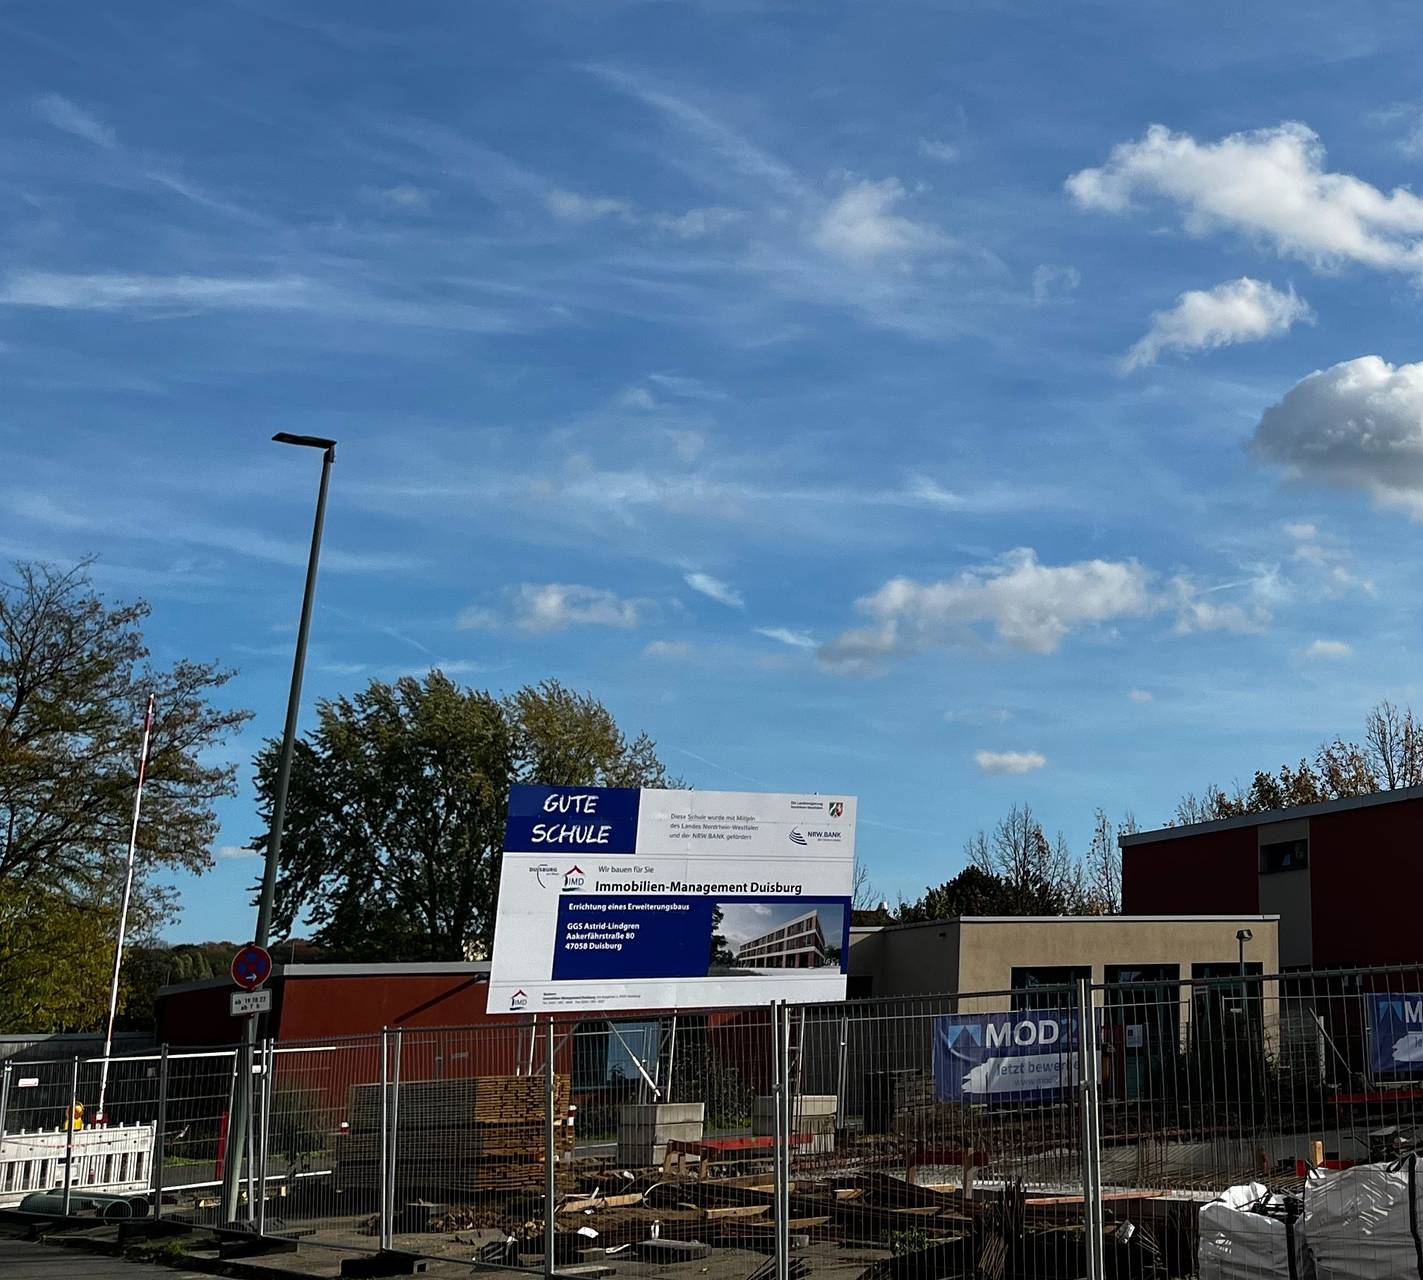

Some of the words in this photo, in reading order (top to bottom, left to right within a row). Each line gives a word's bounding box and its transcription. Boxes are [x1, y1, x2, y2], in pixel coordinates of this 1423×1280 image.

[543, 794, 599, 813] GUTE
[531, 824, 612, 843] SCHULE
[595, 880, 748, 895] Immobilien-Management
[750, 881, 802, 895] Duisburg
[568, 902, 606, 912] Errichtung
[607, 903, 627, 911] eines
[627, 902, 690, 912] Erweiterungsbaus
[567, 922, 583, 930] GGS
[584, 922, 640, 931] Astrid-Lindgren
[566, 932, 625, 940] Aakerfährstraße
[625, 932, 635, 940] 80
[565, 942, 588, 950] 47058
[589, 942, 623, 951] Duisburg
[986, 1018, 1078, 1049] MOD2
[996, 1061, 1025, 1075] Jetzt
